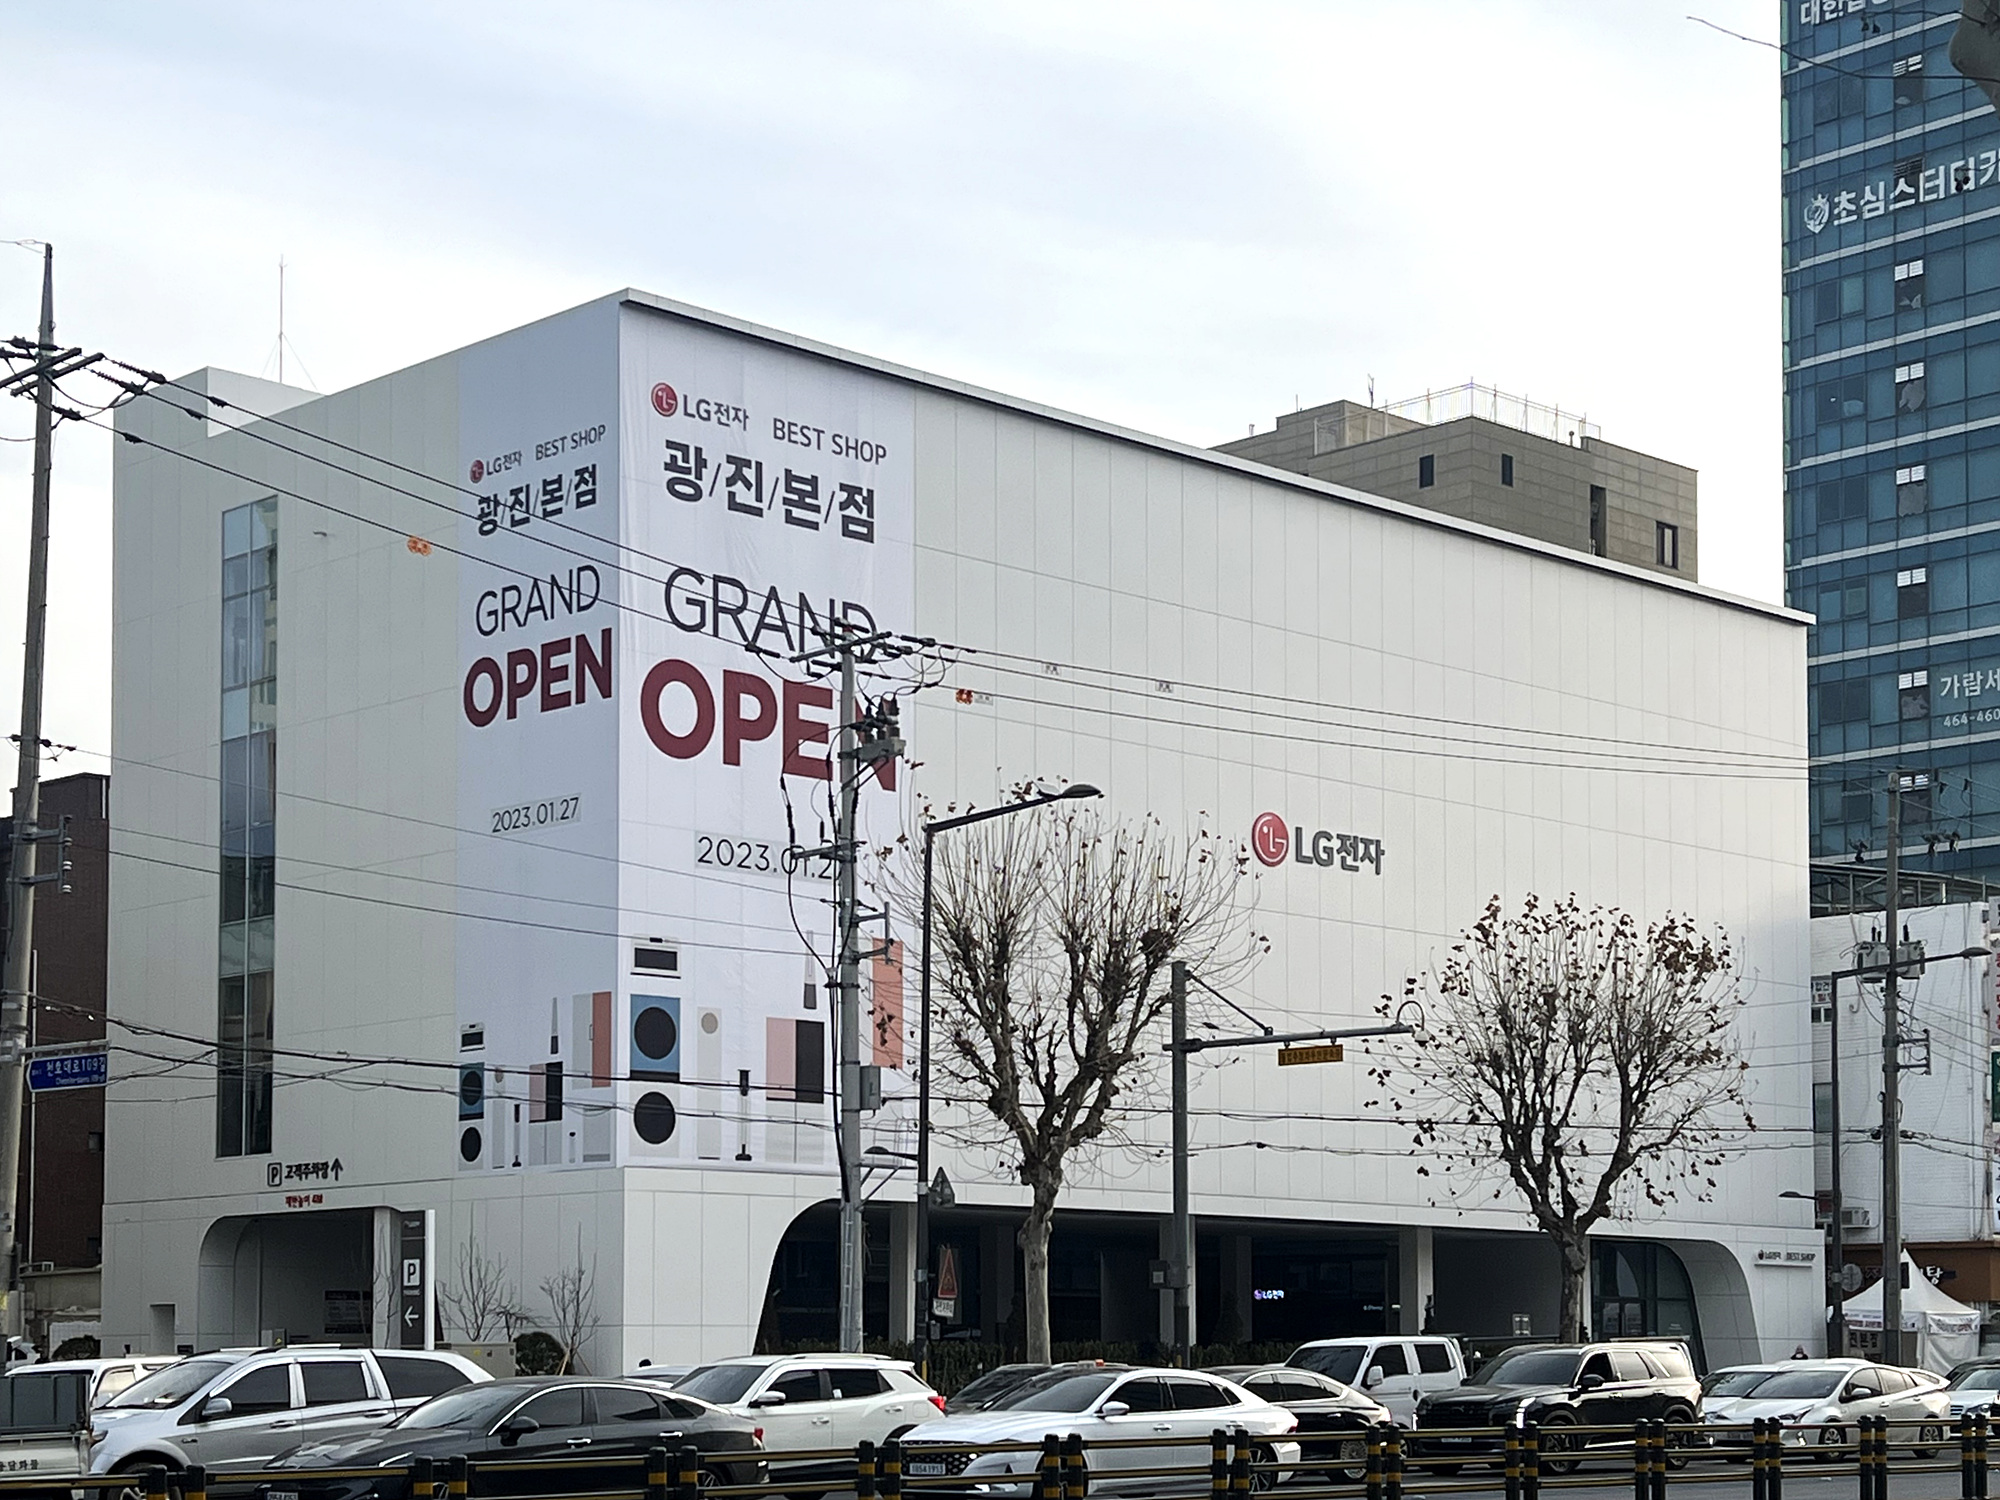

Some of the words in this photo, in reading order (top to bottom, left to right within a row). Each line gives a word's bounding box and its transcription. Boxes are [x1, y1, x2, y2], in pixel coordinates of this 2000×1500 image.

[1801, 0, 1890, 26] 대한
[486, 450, 522, 476] LG전자
[535, 436, 567, 460] BEST
[570, 424, 606, 449] SHOP
[683, 394, 749, 431] LG전자
[773, 417, 825, 450] BEST
[832, 433, 887, 465] SHOP
[478, 463, 597, 536] 광/진/본/점
[664, 439, 875, 544] 광/진/본/점
[476, 565, 599, 636] GRAND
[665, 567, 877, 663] GRAND
[463, 627, 612, 728] OPEN
[492, 797, 579, 833] 2023.01.27
[697, 836, 840, 880] 2023.01.2
[1295, 826, 1386, 876] LG전자
